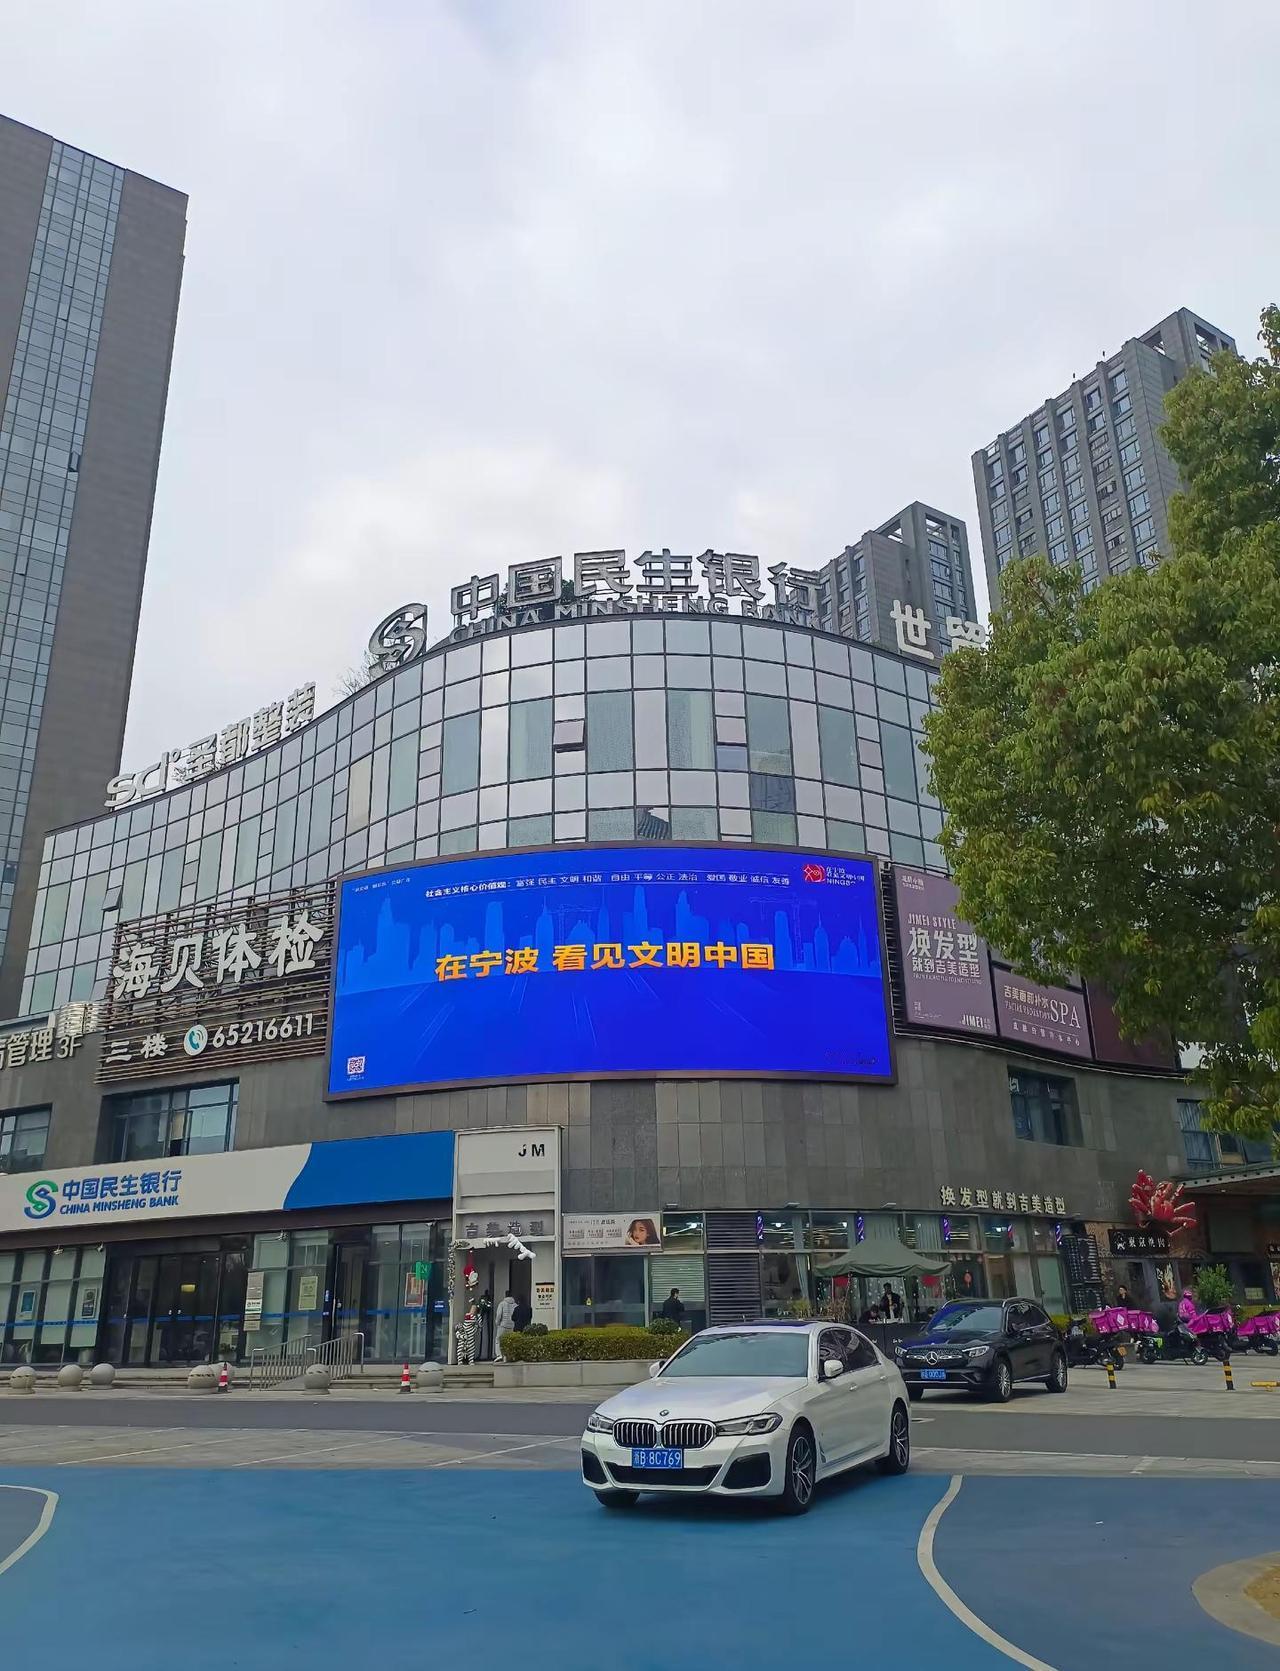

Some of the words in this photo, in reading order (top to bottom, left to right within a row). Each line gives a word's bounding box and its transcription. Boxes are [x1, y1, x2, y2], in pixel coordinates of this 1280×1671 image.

[451, 548, 823, 619] 中国民生银行
[450, 607, 541, 643] CHINA
[554, 596, 729, 620] MINSHENG
[741, 600, 820, 629] BANK
[908, 913, 931, 926] JIMEI
[932, 916, 957, 930] STYLE
[112, 909, 324, 1000] 海贝体检
[434, 947, 540, 981] 在宁波
[552, 941, 776, 970] 看见文明中国
[906, 927, 979, 963] 换发型
[912, 956, 981, 979] 就到吉美造型
[961, 1014, 984, 1029] JIMEI
[1050, 999, 1081, 1029] SPA
[57, 1034, 82, 1059] 3F
[106, 1034, 169, 1062] 三楼
[212, 1013, 313, 1048] 65216611
[62, 1169, 182, 1201] 中国民生银行
[60, 1204, 90, 1214] CHINA
[92, 1199, 147, 1212] MINSHENG
[149, 1195, 179, 1207] BANK
